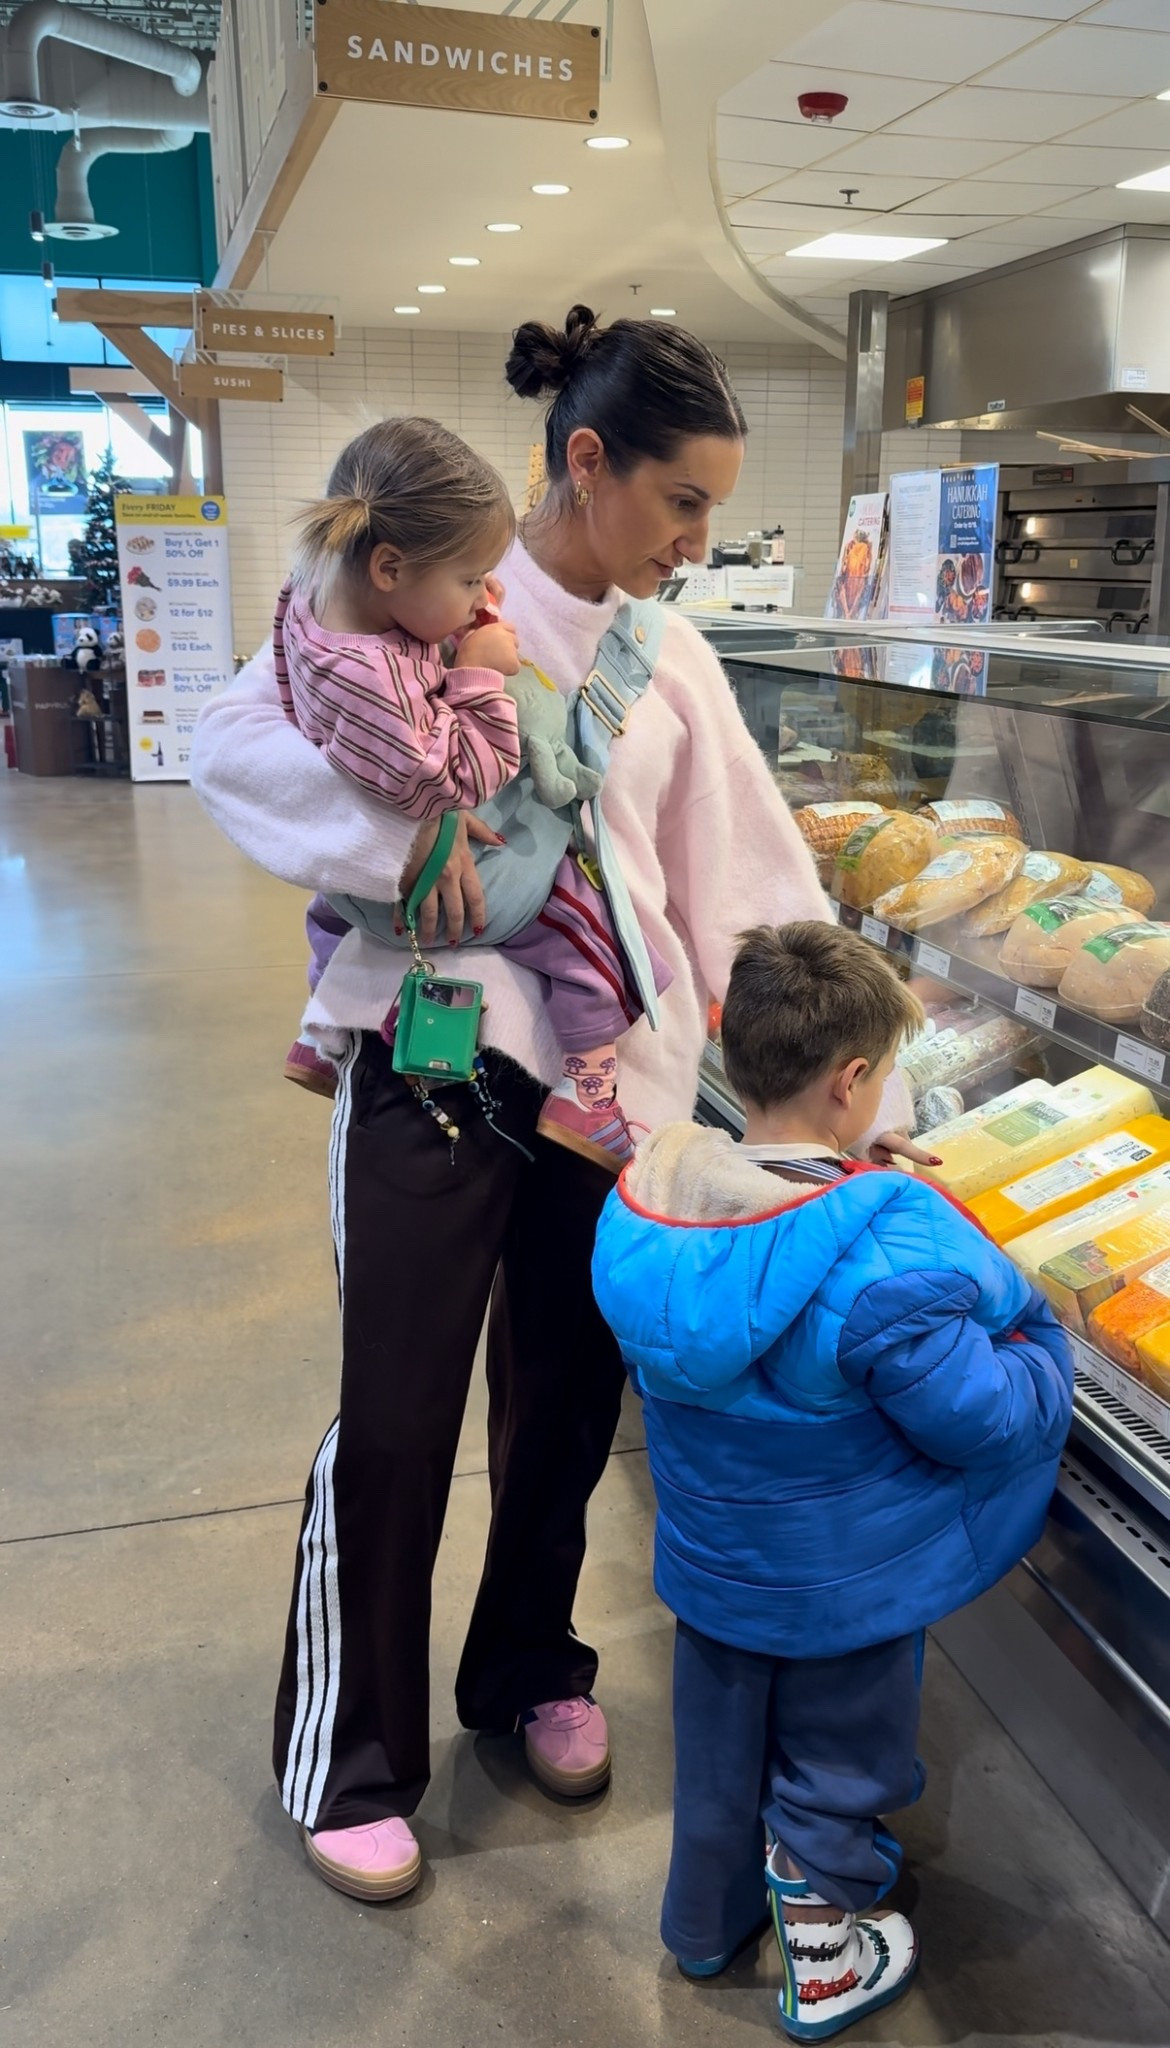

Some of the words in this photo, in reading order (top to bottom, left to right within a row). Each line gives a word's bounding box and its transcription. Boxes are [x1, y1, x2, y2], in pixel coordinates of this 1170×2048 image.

[347, 35, 574, 82] SANDWICHES
[212, 323, 247, 336] PIES
[254, 326, 264, 337] &
[271, 327, 325, 341] SLICES
[213, 376, 251, 388] SUSHI
[947, 484, 988, 504] HANUKKAH
[146, 503, 176, 511] FRIDAY
[952, 504, 981, 519] CATERING
[165, 538, 182, 548] Buy
[185, 539, 193, 548] 1,
[195, 538, 212, 547] Get
[214, 539, 219, 547] 1
[165, 549, 186, 558] 50%
[188, 549, 204, 558] Off
[167, 578, 194, 587] $9.99
[196, 578, 219, 587] Each
[169, 609, 179, 617] 12
[181, 608, 195, 617] for
[198, 608, 214, 618] $12
[171, 642, 187, 652] $12
[189, 642, 213, 651] Each
[173, 673, 190, 683] Buy
[193, 674, 201, 683] 1,
[203, 673, 220, 682] Get
[174, 684, 194, 693] 50%
[196, 684, 212, 693] Off
